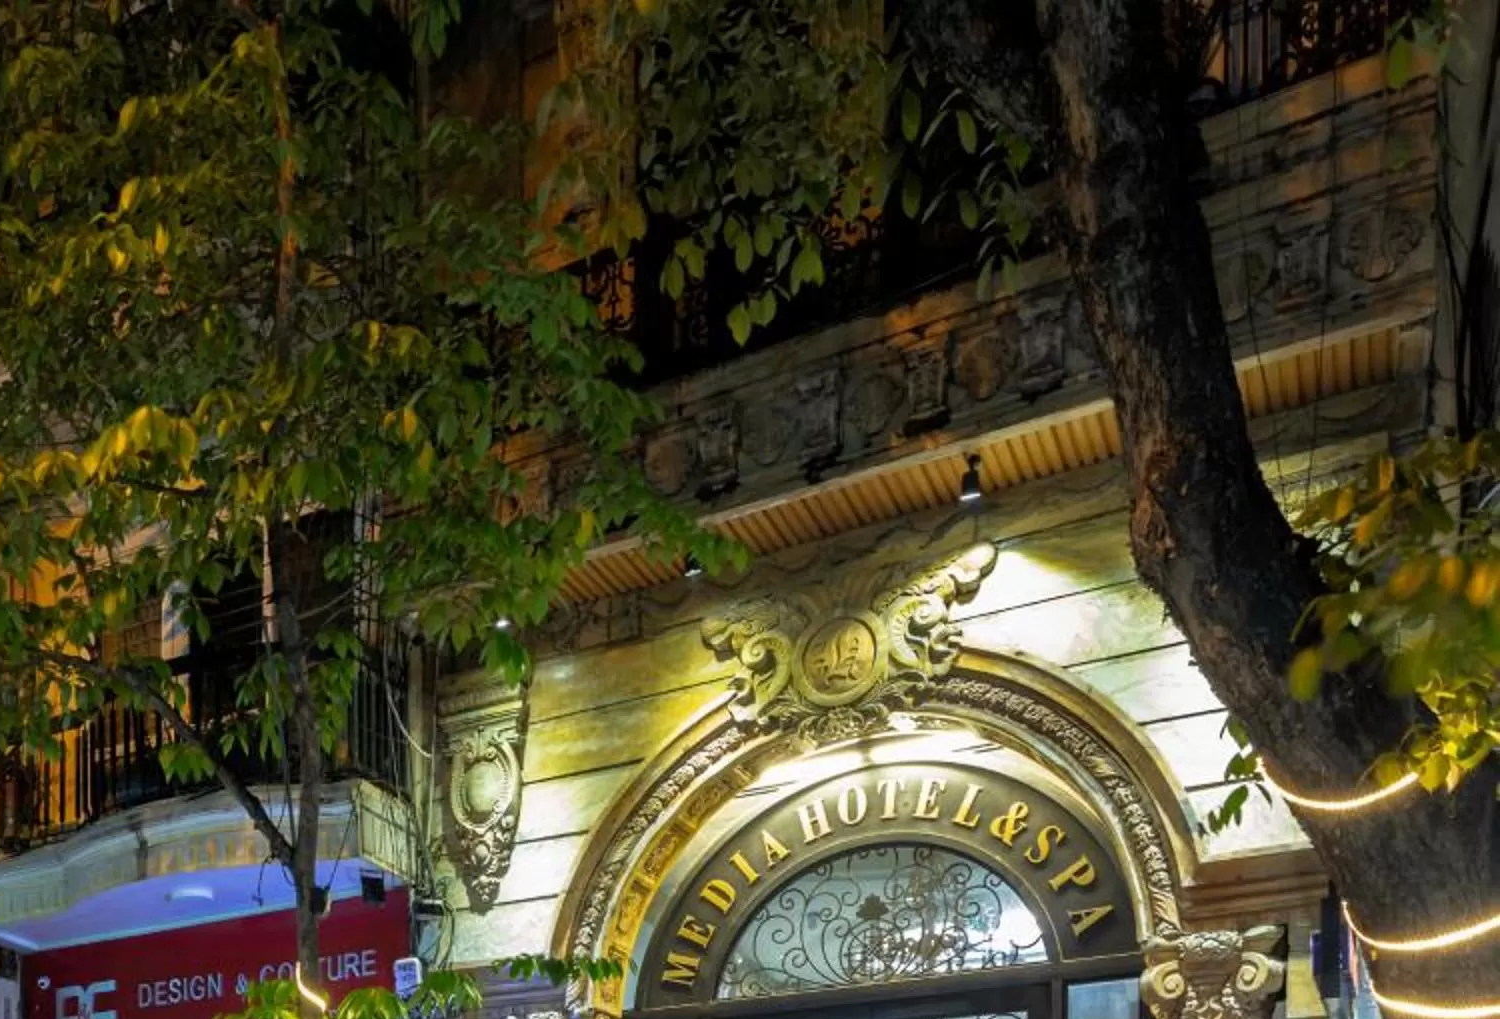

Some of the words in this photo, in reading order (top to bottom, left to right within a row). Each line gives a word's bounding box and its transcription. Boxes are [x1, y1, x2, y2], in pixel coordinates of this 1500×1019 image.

[661, 829, 791, 987] MEDIA
[797, 778, 984, 843] HOTEL
[989, 801, 1029, 847] &
[1024, 825, 1114, 937] SPA
[137, 973, 223, 1009] DESIGN
[235, 972, 248, 996] &
[259, 949, 378, 984] COTURE
